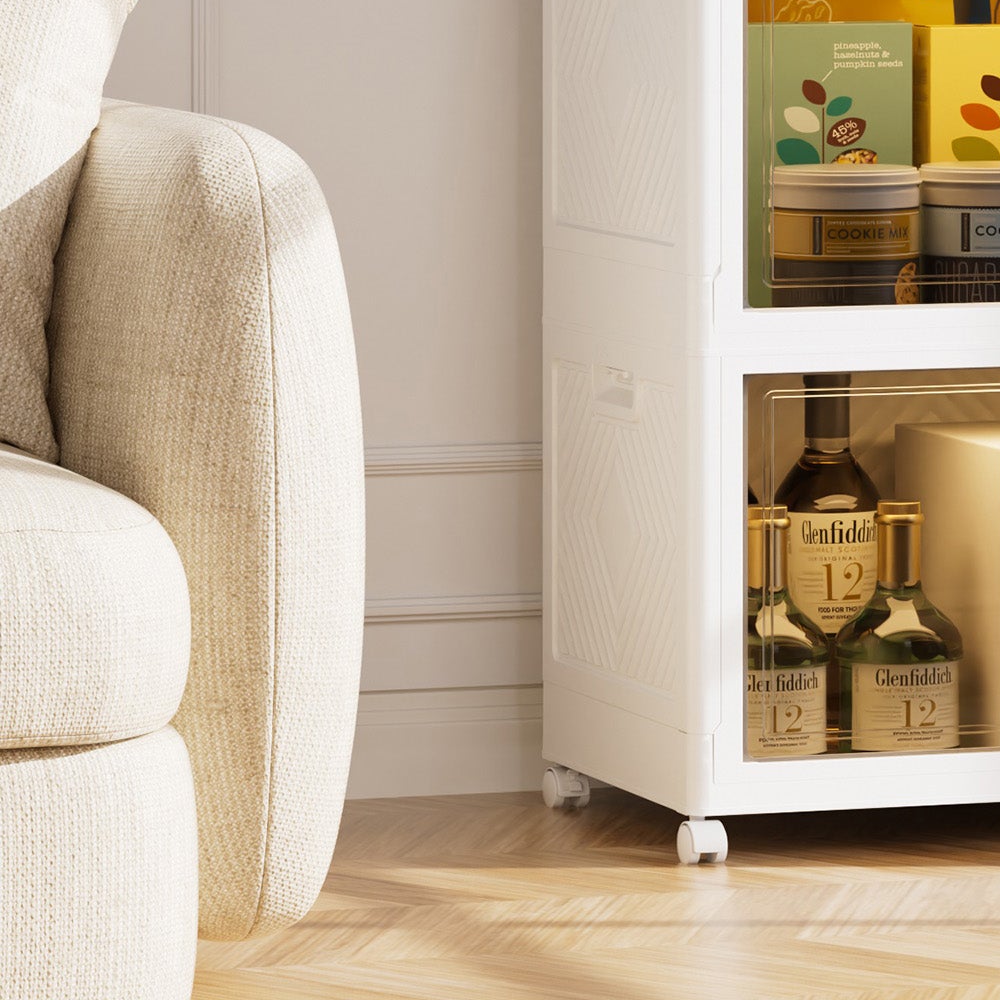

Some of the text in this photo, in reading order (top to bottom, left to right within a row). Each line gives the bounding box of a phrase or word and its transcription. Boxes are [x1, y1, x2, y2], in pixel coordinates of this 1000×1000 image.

[833, 41, 881, 50] pineapple,
[833, 51, 890, 59] hazelnuts &
[833, 60, 903, 69] pumpkin seeds
[832, 120, 857, 138] 45%
[827, 227, 909, 240] COOKIE MIX
[821, 562, 864, 601] 12
[875, 666, 952, 687] Glenfiddich
[767, 705, 802, 733] 12
[901, 699, 937, 728] 12
